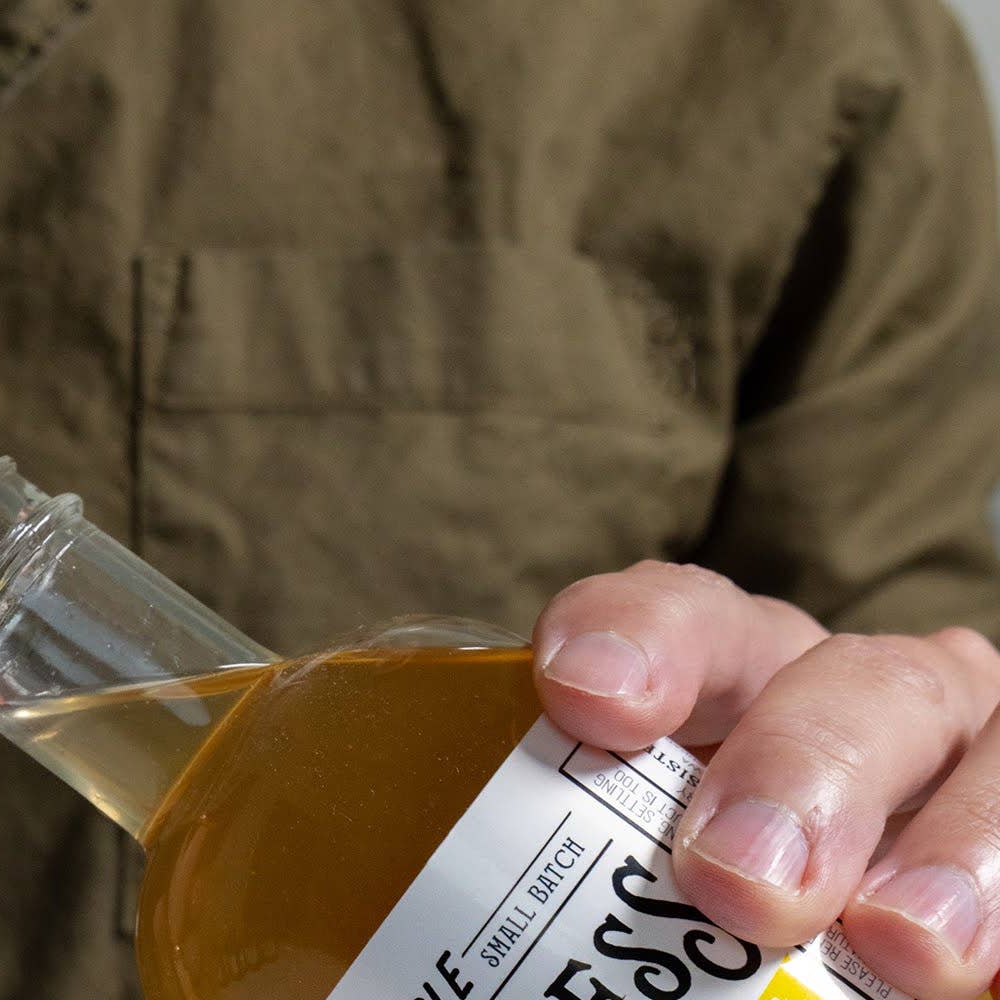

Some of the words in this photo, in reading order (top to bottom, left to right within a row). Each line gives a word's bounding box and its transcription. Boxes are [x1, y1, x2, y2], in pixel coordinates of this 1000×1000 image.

[593, 773, 656, 824] SETTLING
[642, 791, 657, 806] IS
[480, 905, 537, 968] SMALL
[527, 836, 585, 905] BATCH
[840, 954, 893, 1000] PLEASE
